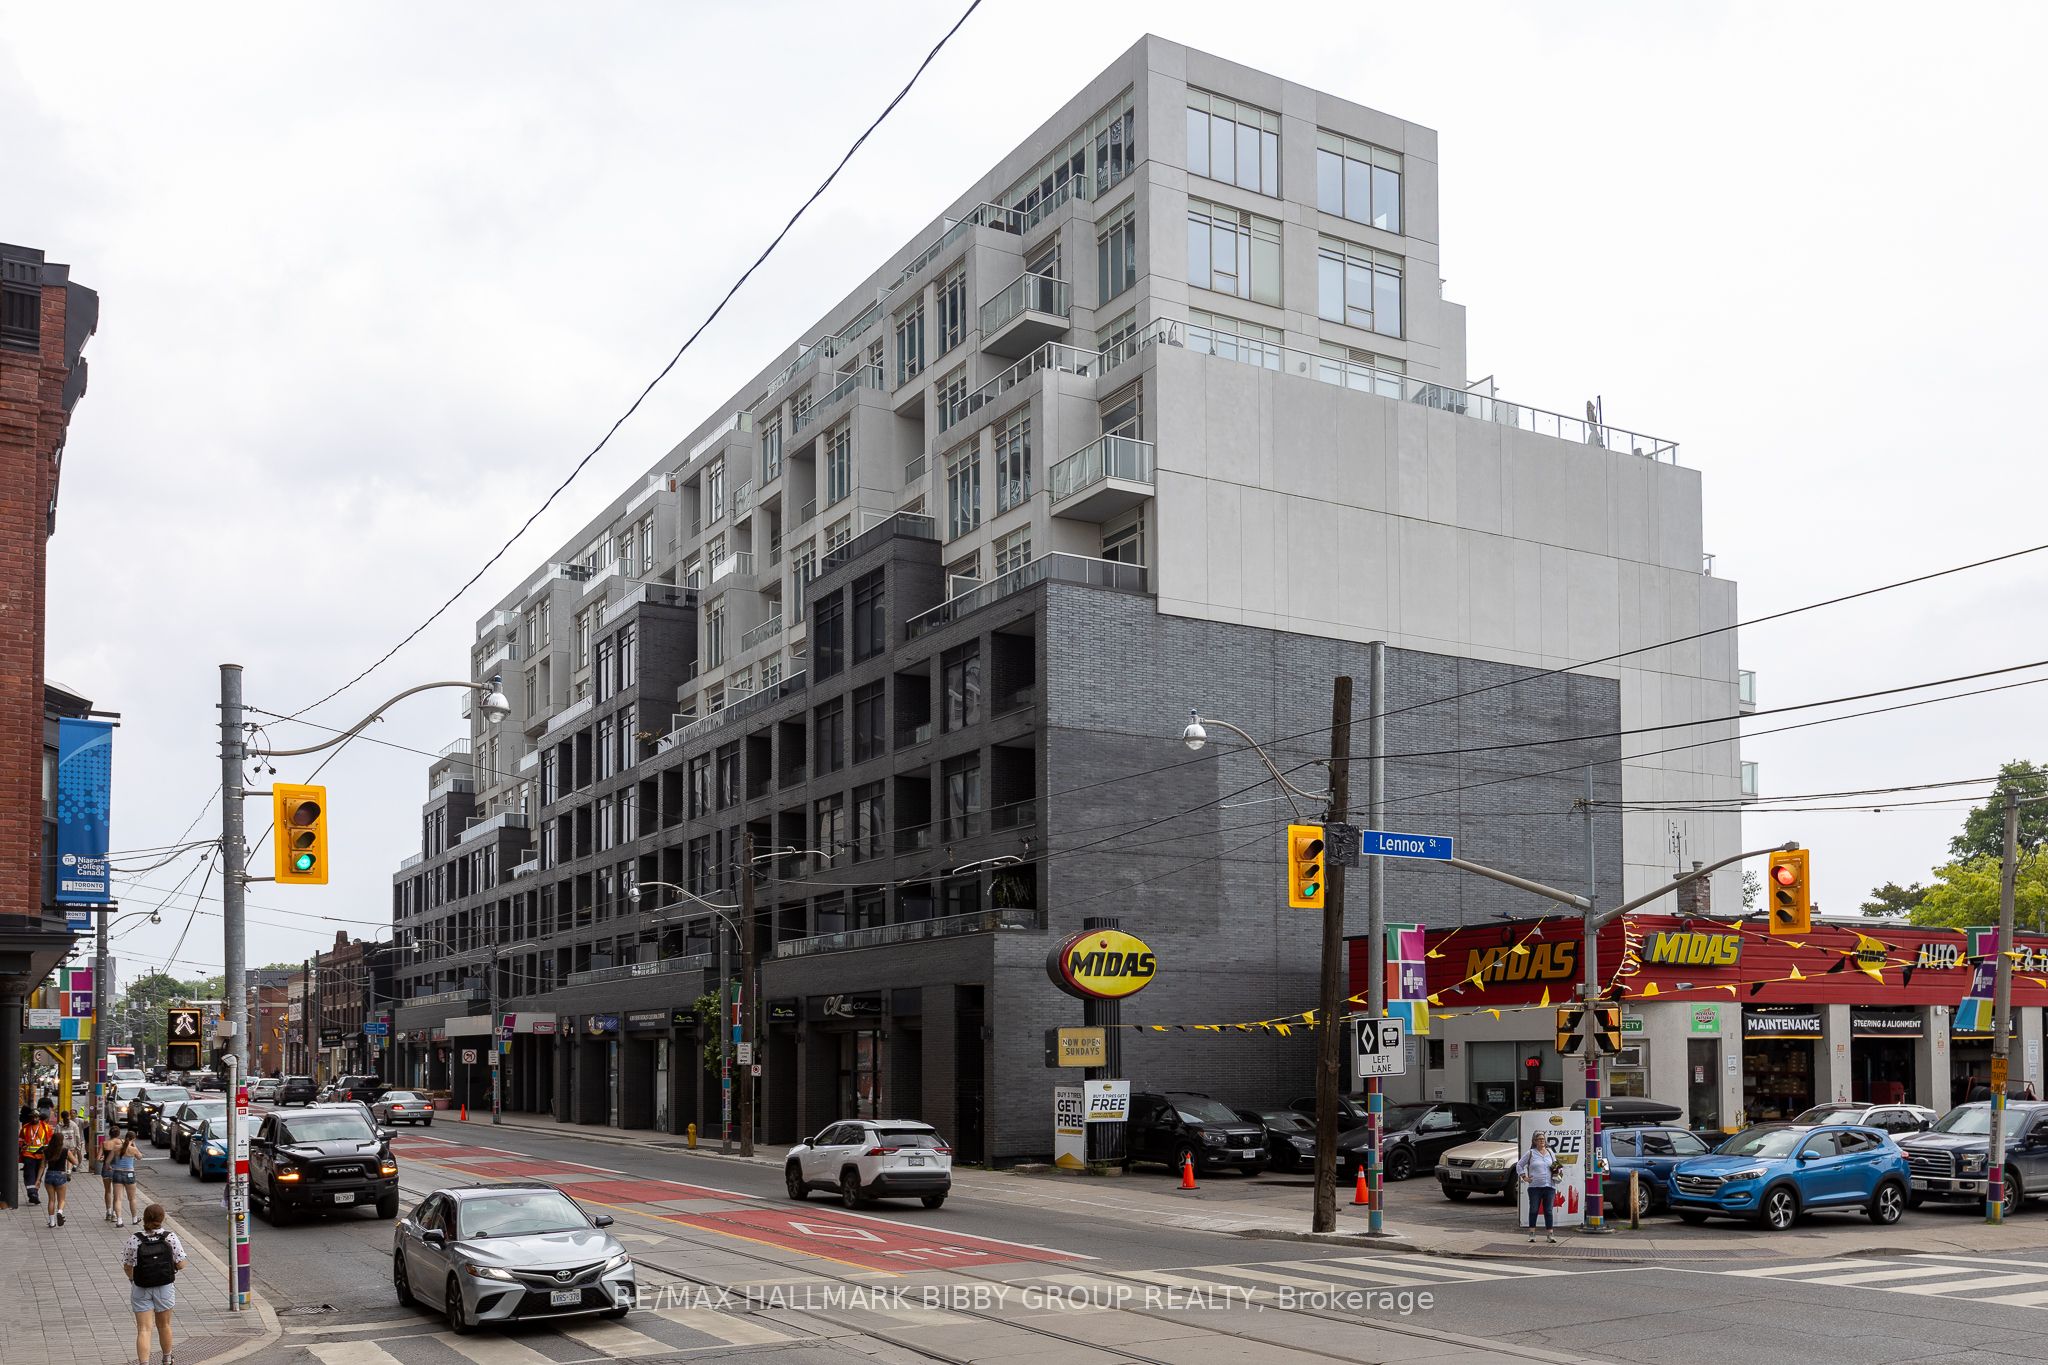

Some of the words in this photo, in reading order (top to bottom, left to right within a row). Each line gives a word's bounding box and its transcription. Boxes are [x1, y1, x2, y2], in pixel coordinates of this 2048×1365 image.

[1379, 834, 1425, 853] Lennox
[1429, 839, 1437, 848] St
[1652, 931, 1740, 965] MIDAS
[1464, 942, 1575, 982] MIDAS
[1917, 943, 1958, 970] AUTO
[1069, 951, 1156, 977] MIDAS
[1748, 1018, 1820, 1031] MAINTENANCE
[1853, 1019, 1881, 1028] STEERING
[1881, 1020, 1887, 1028] &
[1887, 1020, 1922, 1028] ALIGNMENT
[1062, 1039, 1078, 1047] NOW
[1081, 1038, 1101, 1047] OPEN
[1065, 1047, 1100, 1056] SUNDAYS
[1372, 1055, 1390, 1064] LEFT
[1525, 1058, 1540, 1067] OPEN
[1371, 1064, 1392, 1073] LANE
[1057, 1099, 1077, 1113] GET
[1079, 1100, 1083, 1113] 1
[1091, 1098, 1127, 1111] FREE
[1057, 1113, 1084, 1127] FREE
[1547, 1136, 1582, 1153] REE
